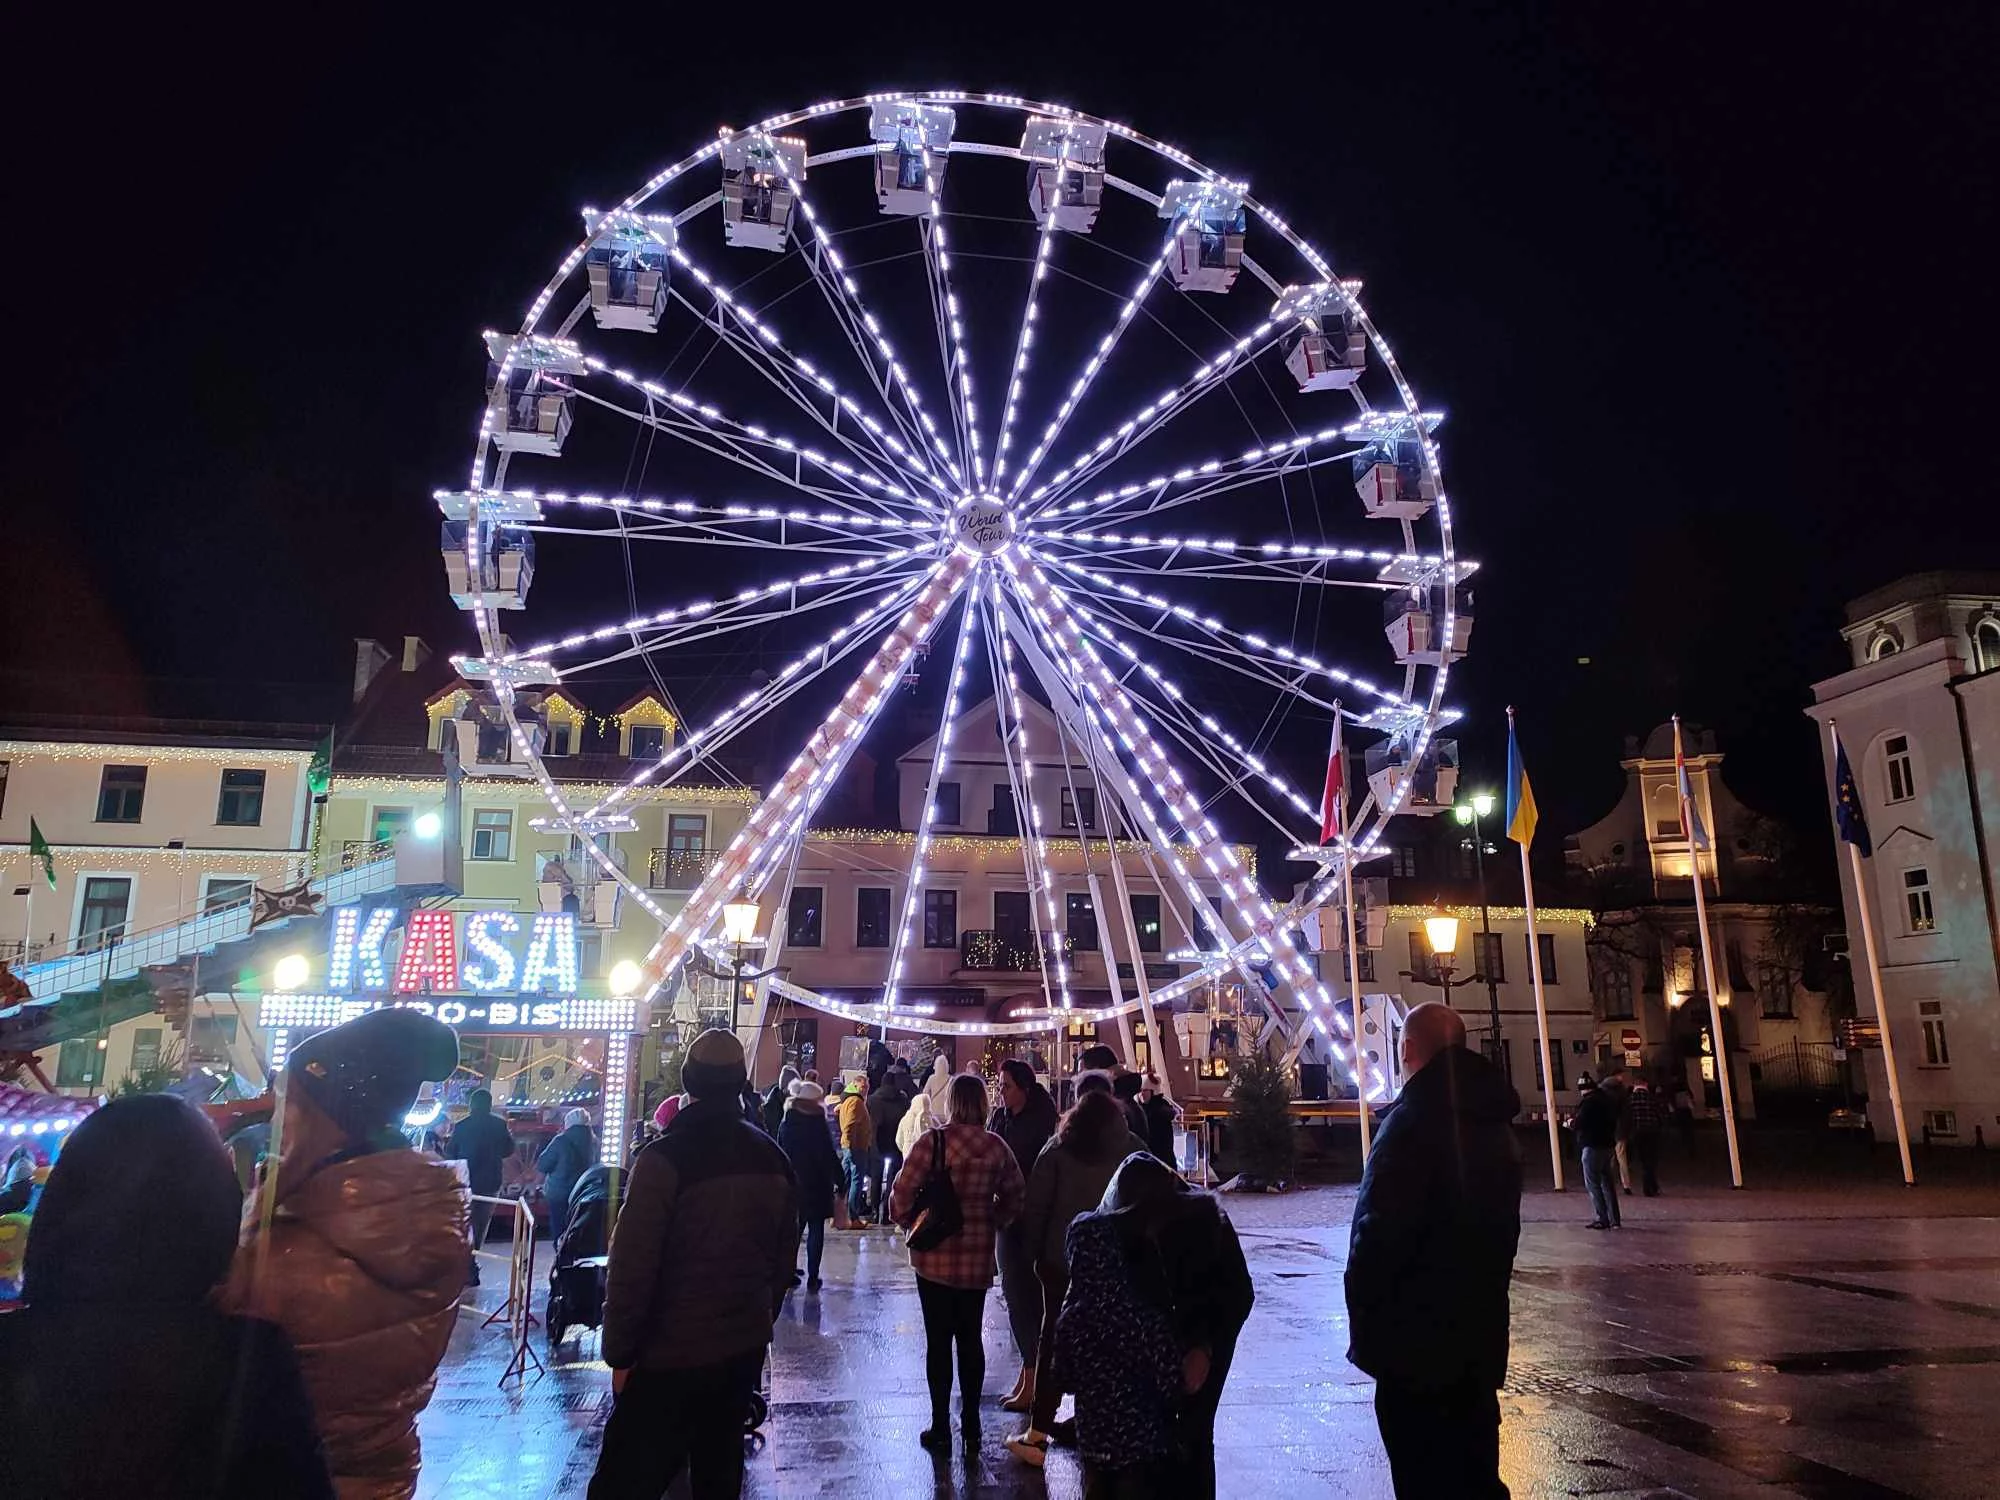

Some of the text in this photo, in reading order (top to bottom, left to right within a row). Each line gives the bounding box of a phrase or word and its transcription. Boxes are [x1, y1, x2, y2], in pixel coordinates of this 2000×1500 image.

[958, 505, 1004, 532] World
[973, 527, 1005, 547] Tour
[330, 907, 577, 991] KASA
[341, 1001, 561, 1026] EO-BIS
